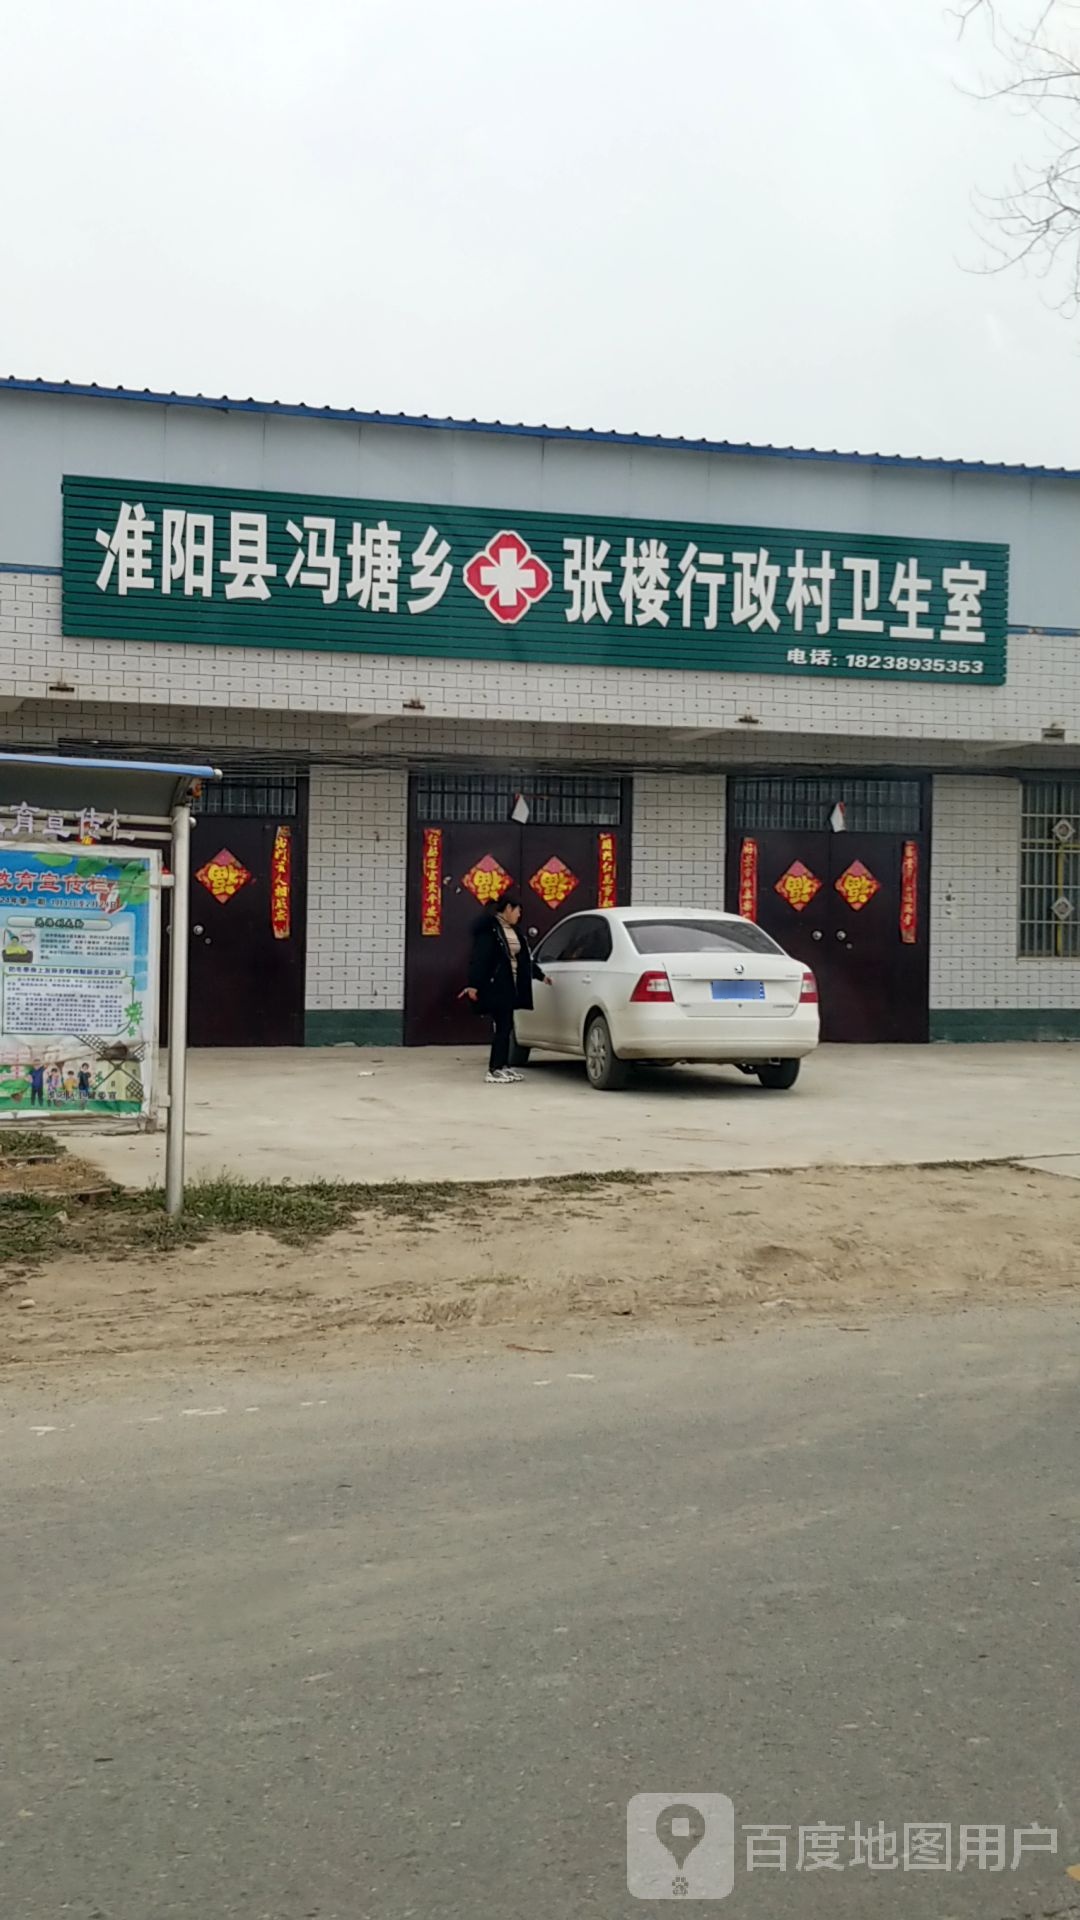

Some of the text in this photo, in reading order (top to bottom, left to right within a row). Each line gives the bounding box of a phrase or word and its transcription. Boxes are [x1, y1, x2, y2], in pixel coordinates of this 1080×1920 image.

[563, 535, 987, 643] 张楼行政村卫生室
[845, 654, 984, 674] 18238935353
[0, 801, 136, 841] 育宣传栏
